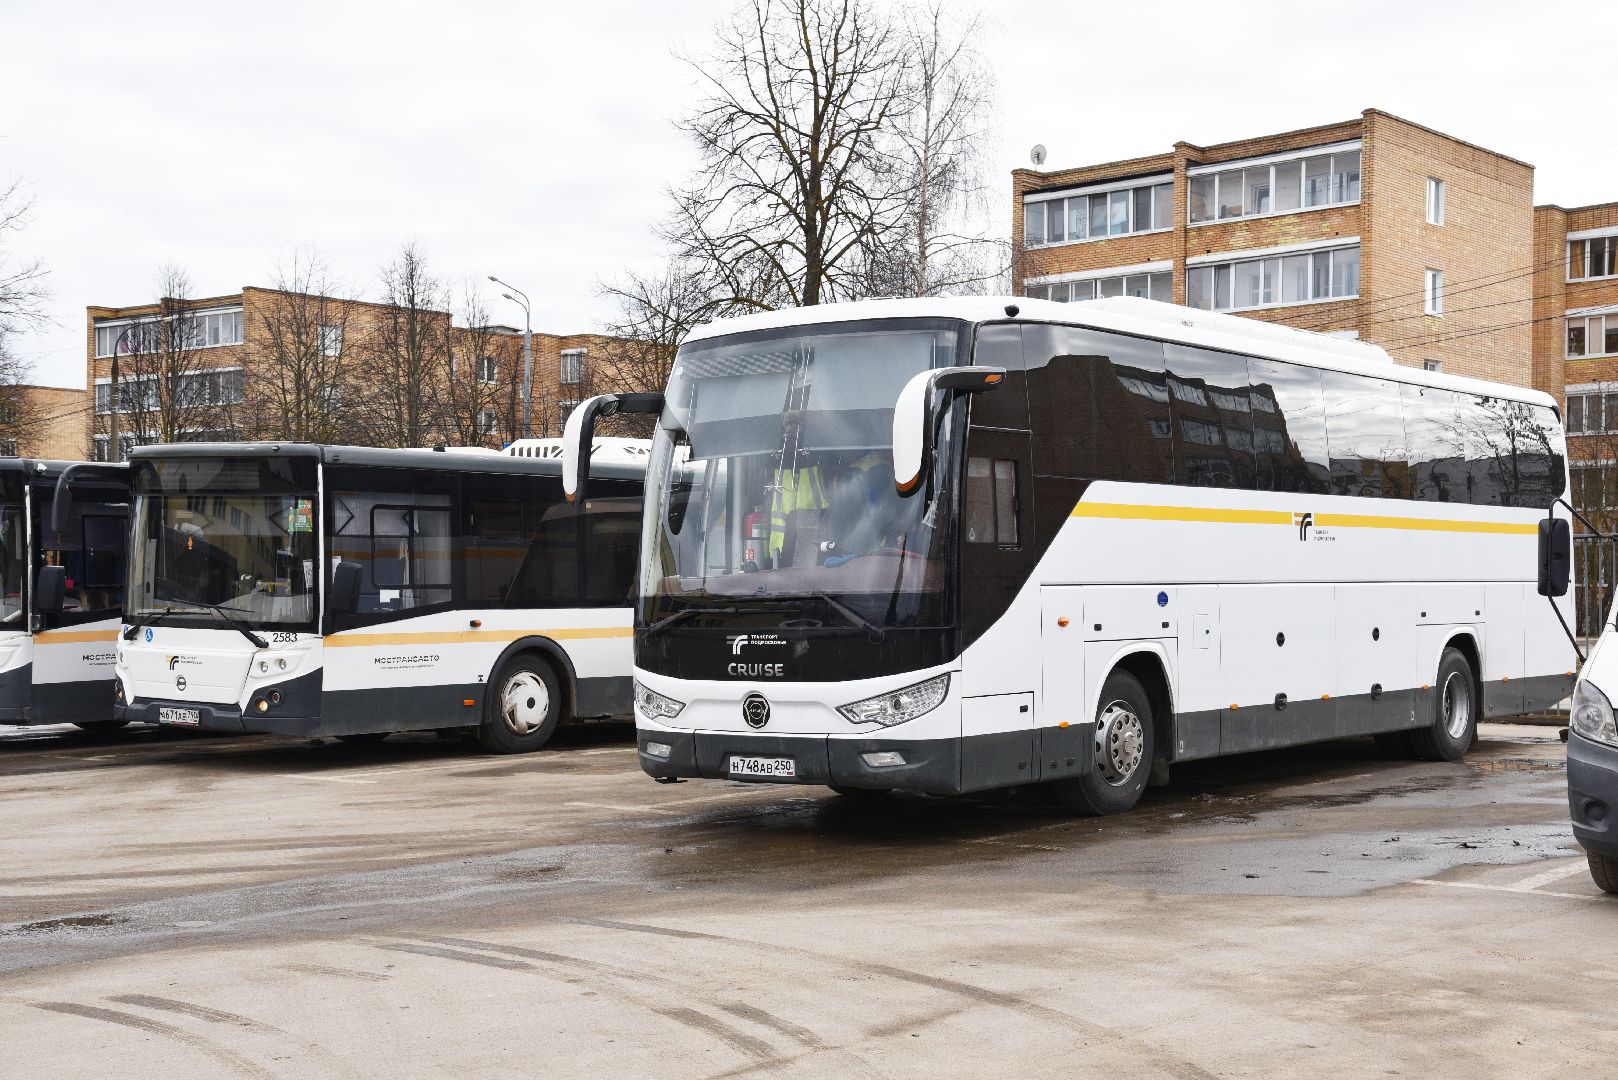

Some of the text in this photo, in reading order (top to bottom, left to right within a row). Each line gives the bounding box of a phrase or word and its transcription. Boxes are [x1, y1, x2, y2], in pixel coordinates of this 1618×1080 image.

[272, 632, 298, 643] 2583
[374, 654, 440, 665] МОСТРАНСАВТО
[727, 662, 784, 677] CRUISE
